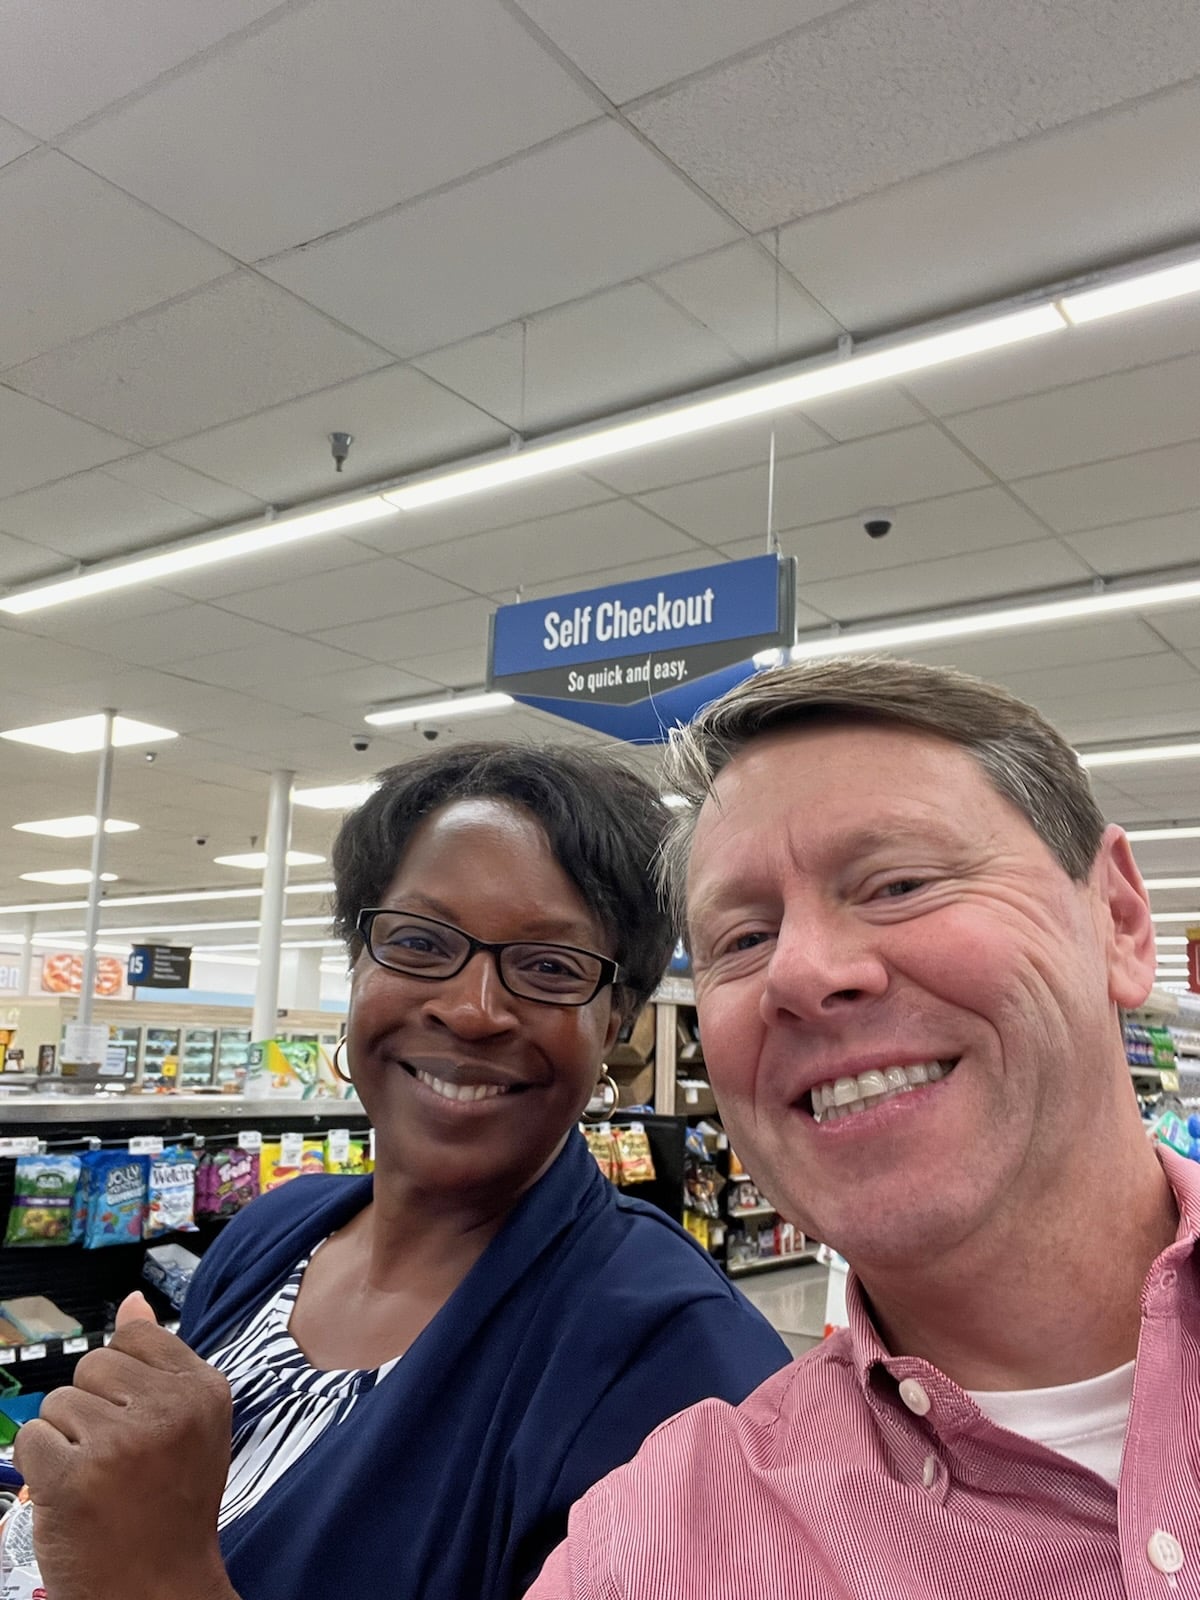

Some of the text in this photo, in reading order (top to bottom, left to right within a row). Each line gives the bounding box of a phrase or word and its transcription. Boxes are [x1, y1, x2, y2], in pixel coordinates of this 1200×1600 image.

[543, 587, 715, 650] Self Checkout
[567, 659, 688, 693] So quick and easy.
[130, 955, 144, 974] 15
[107, 1164, 140, 1188] JOLLY
